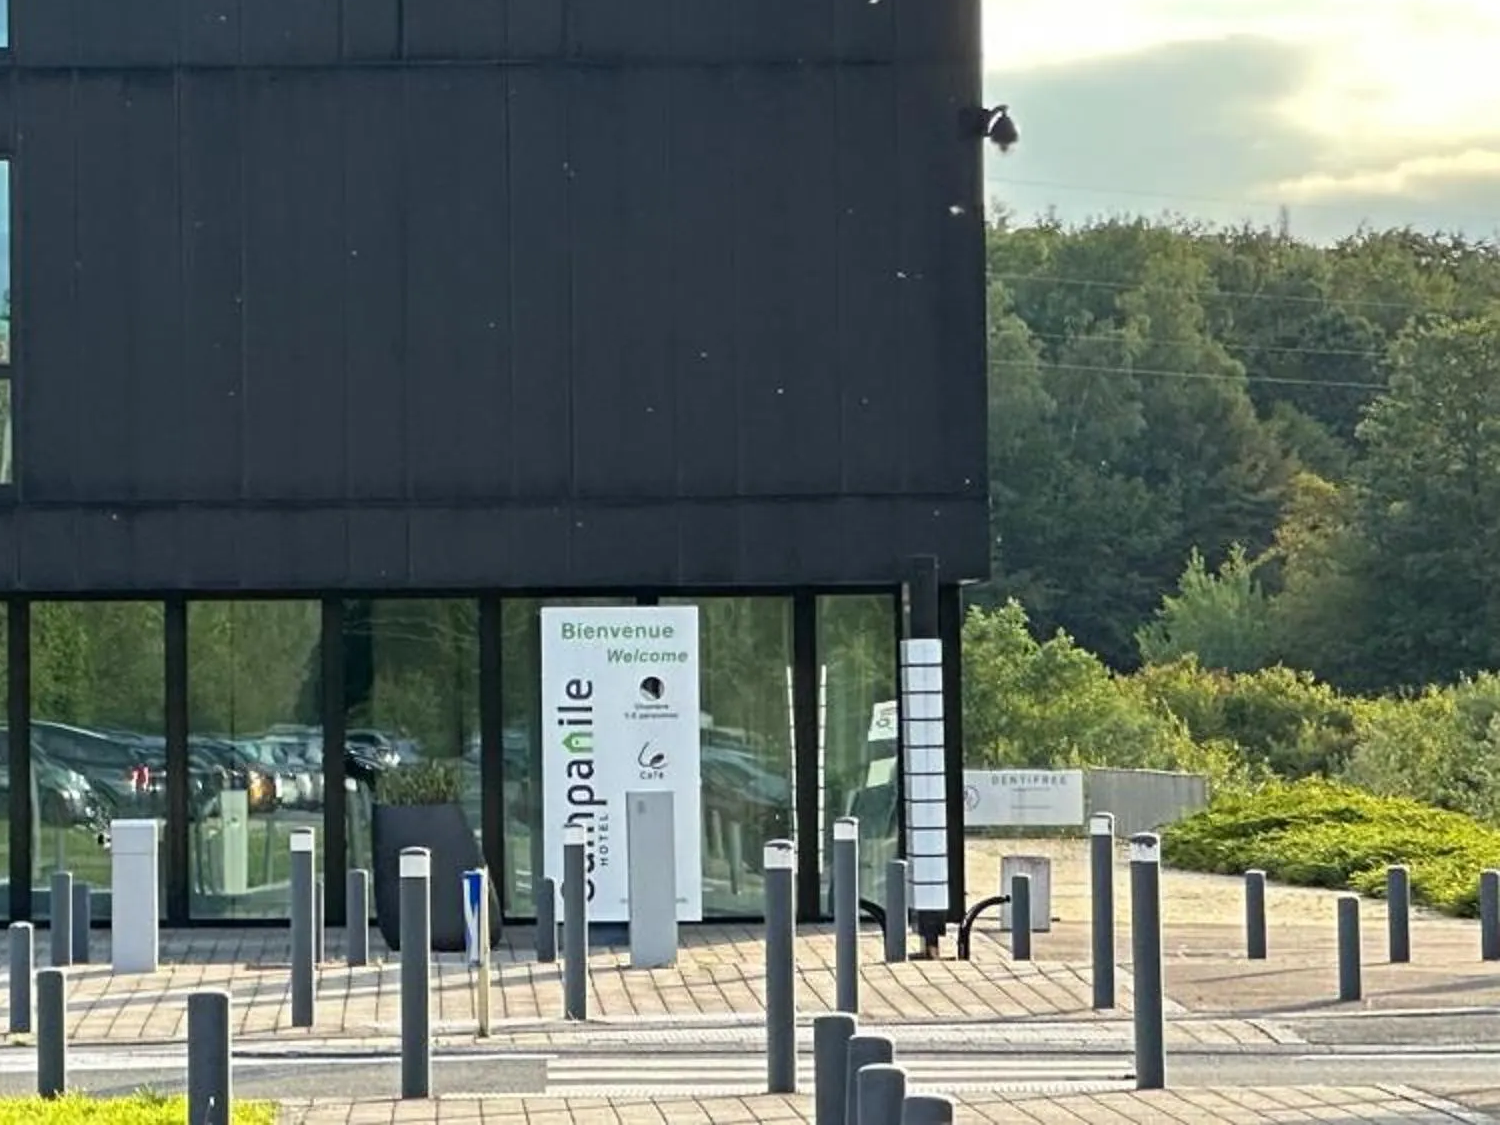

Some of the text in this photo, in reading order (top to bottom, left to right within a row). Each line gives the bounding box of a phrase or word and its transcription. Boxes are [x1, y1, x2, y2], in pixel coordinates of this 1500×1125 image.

[561, 622, 675, 639] Bienvenue
[607, 649, 688, 663] Welcome
[598, 814, 609, 867] HOTEL
